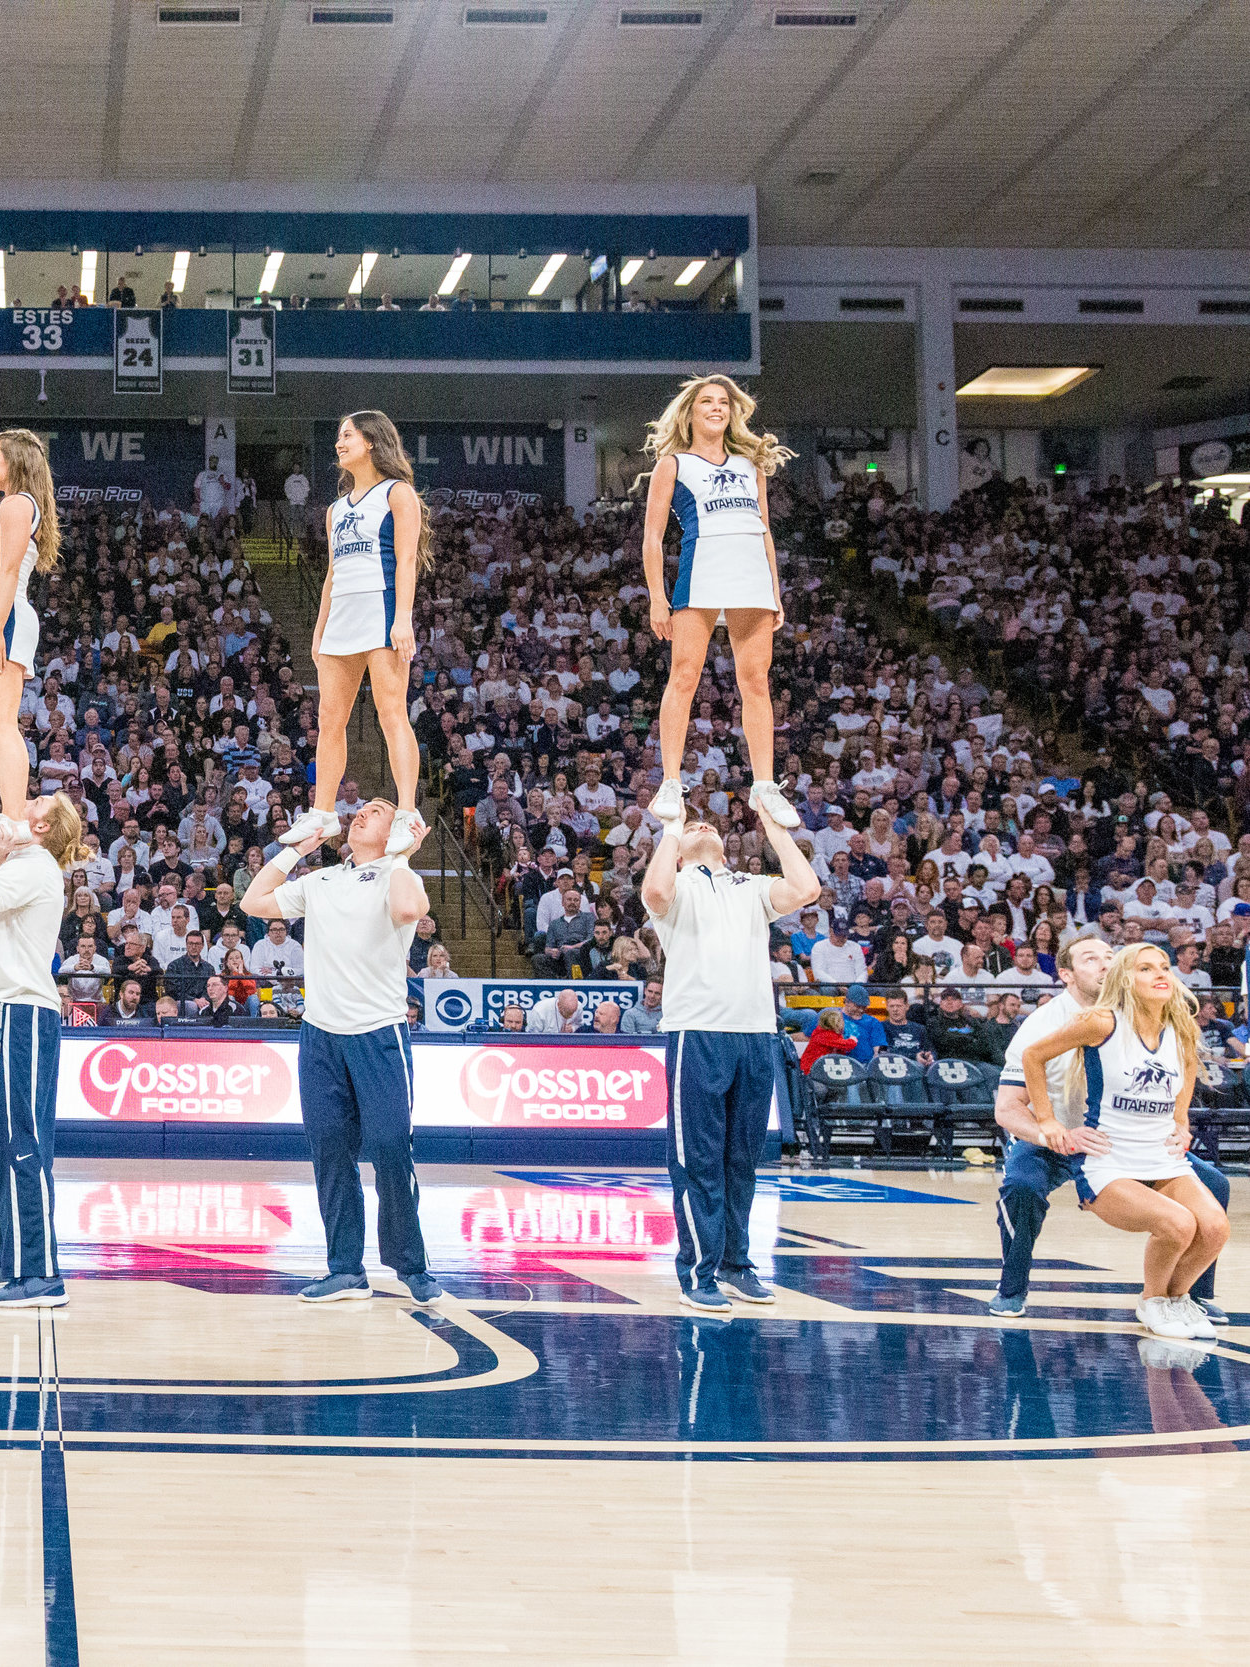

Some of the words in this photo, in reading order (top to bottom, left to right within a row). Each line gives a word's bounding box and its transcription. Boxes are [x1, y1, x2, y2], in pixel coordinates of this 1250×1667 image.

[12, 309, 74, 325] ESTES
[22, 325, 63, 350] 33
[122, 348, 154, 367] 24
[238, 348, 264, 367] 31
[213, 425, 228, 440] A
[574, 428, 588, 443] B
[935, 429, 950, 446] C
[81, 431, 146, 461] WE
[462, 435, 544, 465] WIN
[56, 485, 103, 504] Sign
[104, 486, 143, 501] Pro
[704, 497, 734, 513] UTAH
[343, 541, 373, 555] STATE
[486, 989, 534, 1009] CBS
[538, 990, 634, 1010] SORTS
[89, 1043, 271, 1116] Gossner
[468, 1048, 652, 1121] Gossner
[141, 1097, 244, 1114] FOODS
[522, 1103, 627, 1121] FOODS
[1113, 1096, 1147, 1112] UTAH
[1148, 1101, 1176, 1114] STAT
